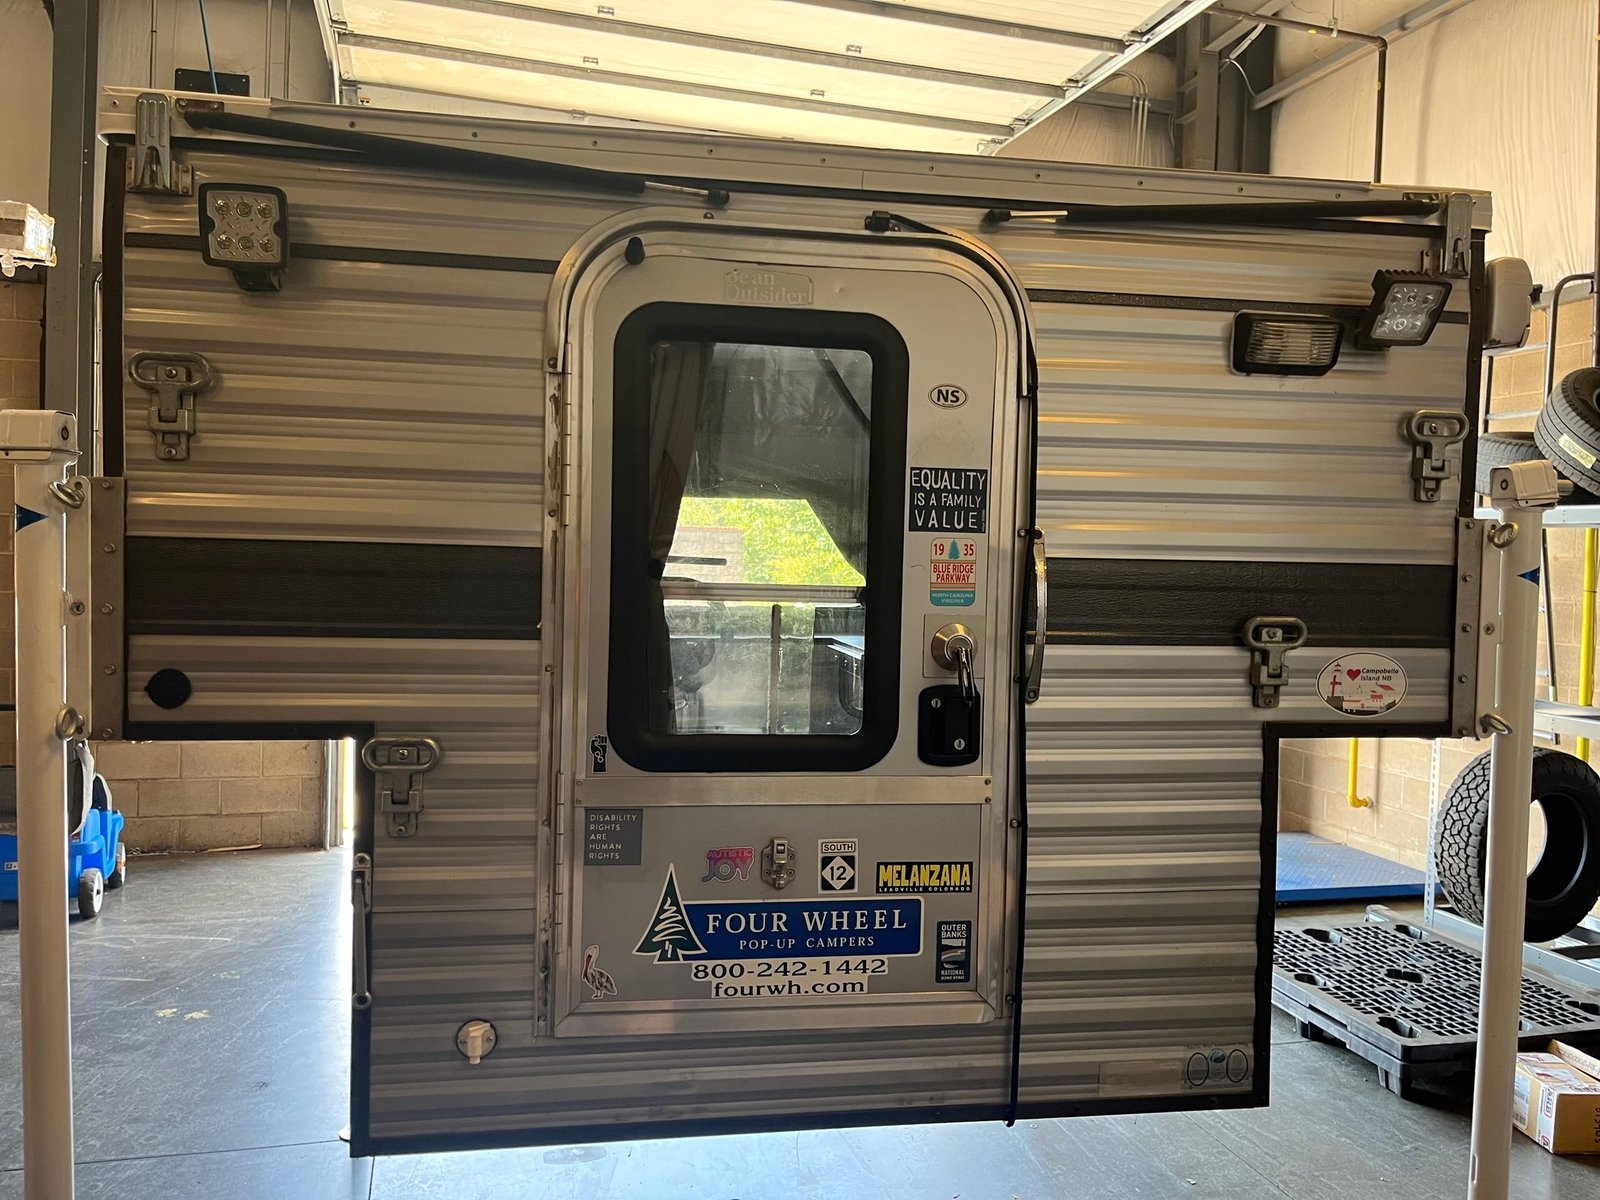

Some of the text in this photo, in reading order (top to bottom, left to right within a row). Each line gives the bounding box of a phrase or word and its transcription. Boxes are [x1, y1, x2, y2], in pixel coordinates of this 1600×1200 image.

[752, 272, 774, 285] an
[726, 283, 807, 304] Outsider
[936, 388, 960, 403] NS
[911, 469, 986, 490] EQUALITY
[914, 492, 981, 508] IS A FAMILY
[914, 509, 978, 529] VALUE
[933, 543, 974, 556] 19 35
[933, 564, 974, 573] BLUE RIDGE
[936, 573, 970, 583] PARKWAY
[1361, 667, 1399, 675] Campobello
[590, 814, 637, 822] DISABILITY
[590, 823, 621, 831] RIGHTS
[590, 833, 607, 841] ARE
[708, 849, 752, 858] AUTISTIC
[824, 843, 853, 851] SOUTH
[589, 852, 620, 860] RIGHTS
[702, 857, 752, 881] JOY
[829, 866, 847, 881] 12
[879, 864, 971, 887] MELANZANA
[707, 909, 907, 934] FOUR WHEEL
[739, 936, 875, 950] POP-UP CAMPERS
[693, 958, 887, 980] 800-242-1442
[713, 979, 865, 998] fourwh.com
